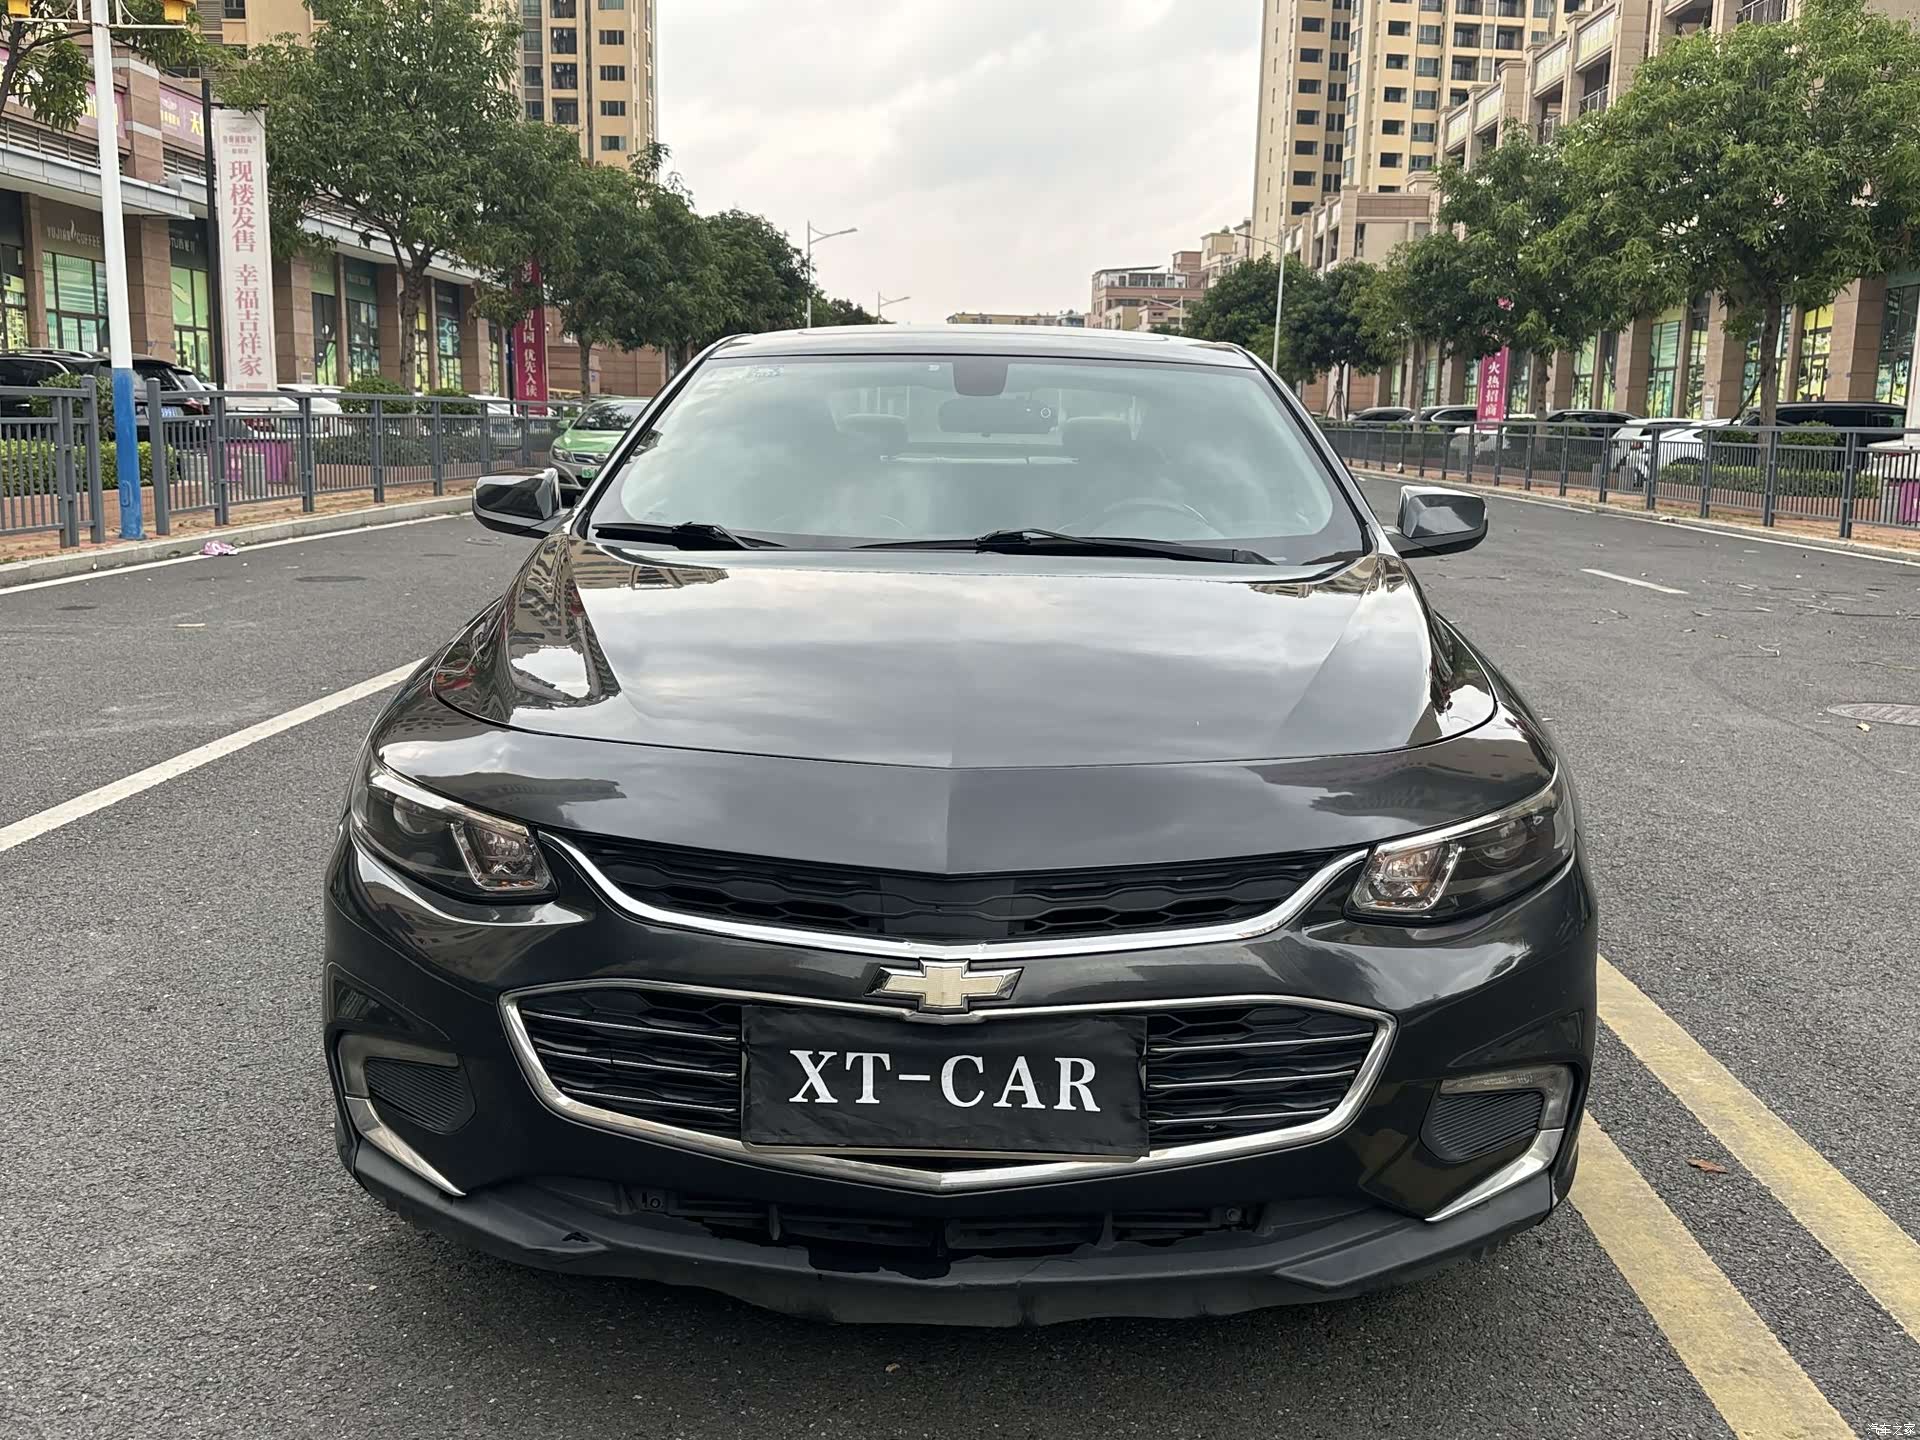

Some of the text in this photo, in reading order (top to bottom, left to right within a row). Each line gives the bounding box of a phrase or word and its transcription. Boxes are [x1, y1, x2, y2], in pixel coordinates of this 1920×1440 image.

[229, 160, 256, 252] 现楼发售
[76, 231, 101, 248] COFFEE
[235, 264, 263, 377] 幸福吉祥家
[1485, 361, 1500, 416] 火热招商
[788, 1049, 1101, 1112] XT-CAR
